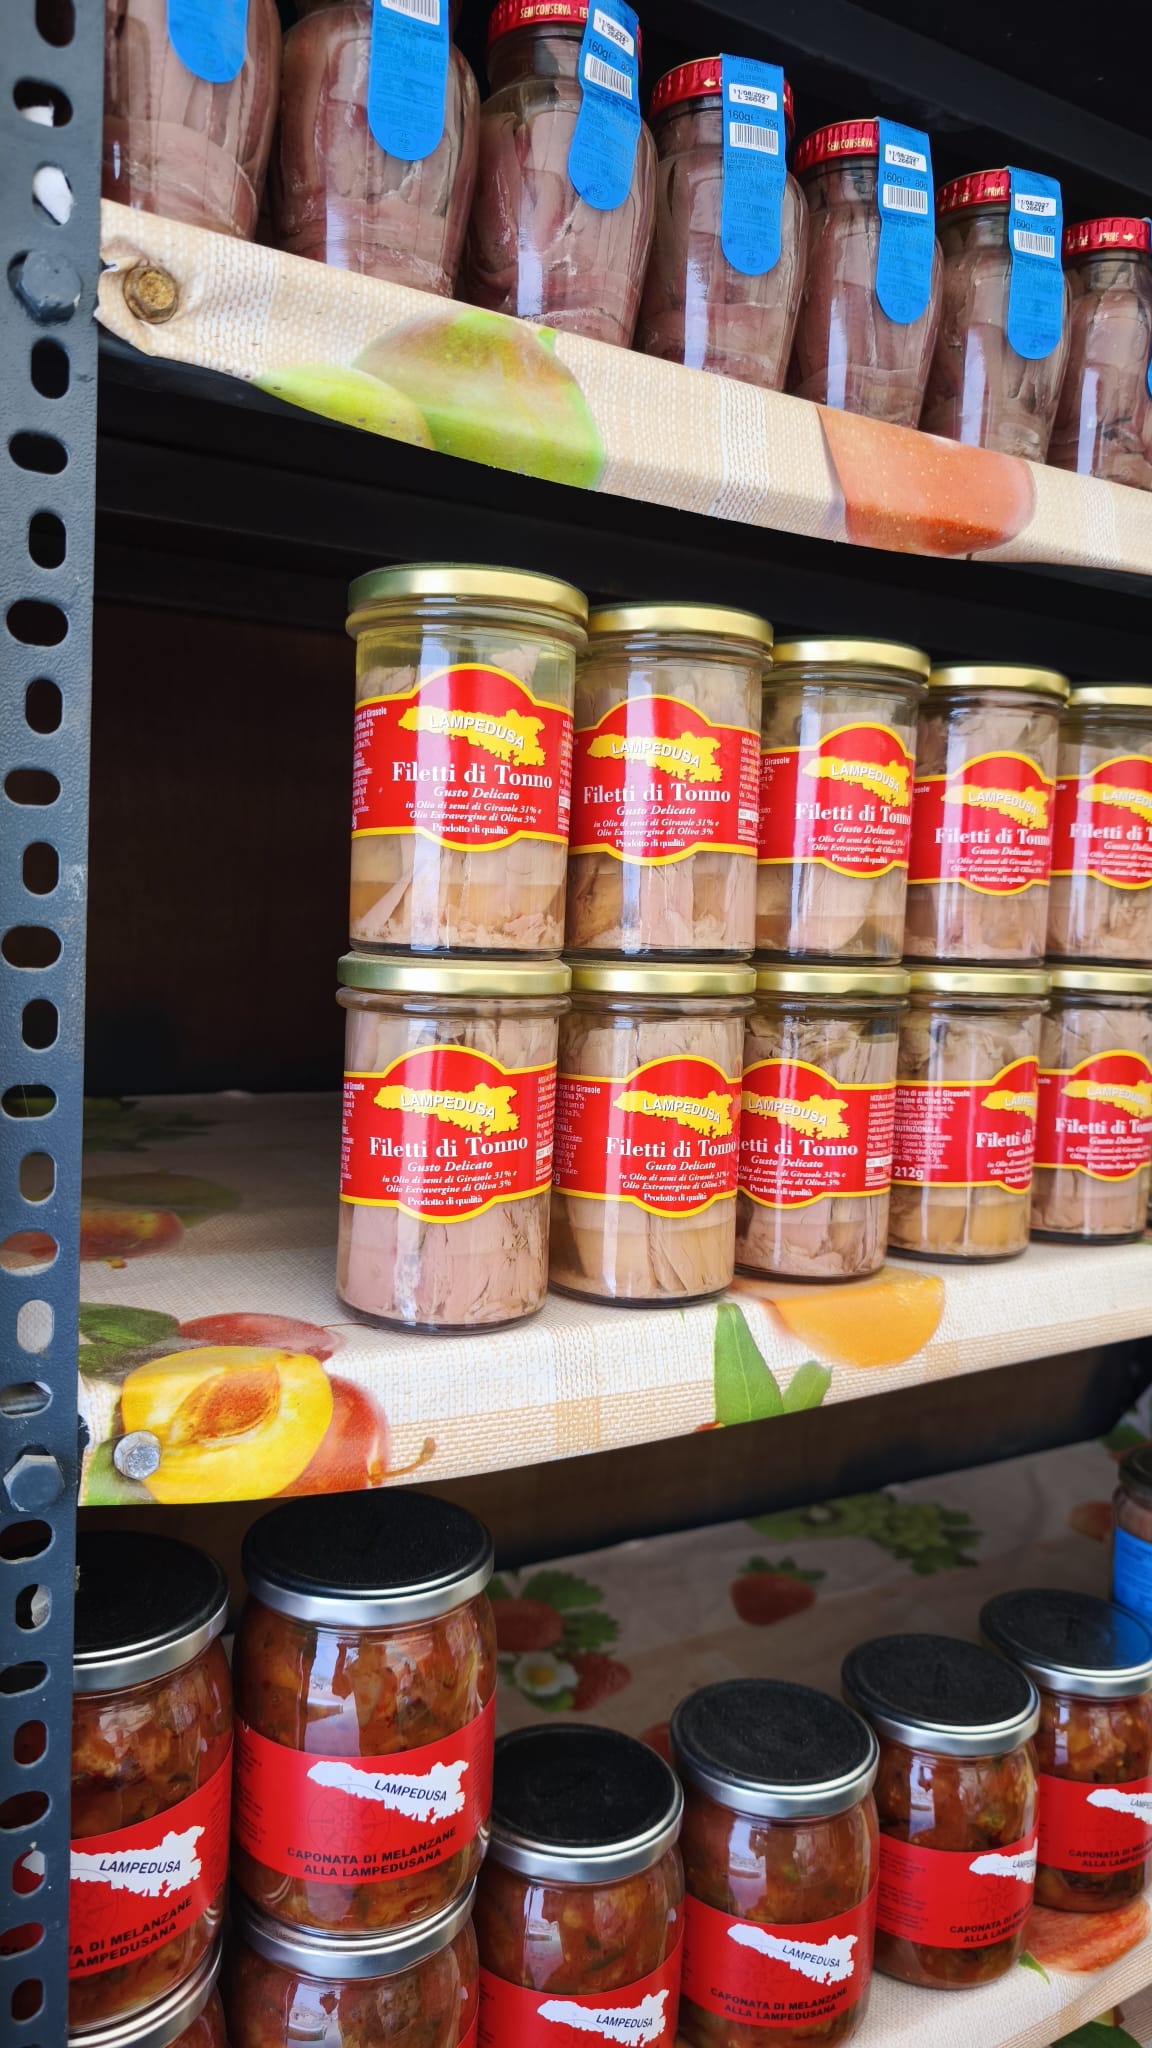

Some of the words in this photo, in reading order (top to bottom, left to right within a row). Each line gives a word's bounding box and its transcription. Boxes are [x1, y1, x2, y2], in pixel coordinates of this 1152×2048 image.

[588, 38, 608, 62] 160g
[728, 109, 750, 123] 160g
[430, 714, 525, 750] LAMPEDUSA
[611, 742, 701, 768] LAMPEDUSA
[391, 761, 456, 783] Filetti
[463, 762, 487, 784] di
[494, 764, 553, 789] Tonno
[831, 763, 900, 793] LAMPEDUSA
[433, 786, 469, 798] Gusto
[471, 787, 520, 801] Delicato
[583, 785, 636, 805] Filetti
[642, 783, 663, 802] di
[670, 783, 731, 803] Tonno
[405, 801, 414, 809] in
[416, 800, 435, 810] Olio
[437, 800, 447, 810] di
[448, 802, 469, 811] semi
[471, 802, 481, 811] di
[483, 803, 519, 813] Girasole
[520, 805, 537, 814] 31%
[616, 805, 651, 816] Gusto
[651, 805, 697, 816] Delicato
[968, 791, 1038, 816] LAMPEDUSA
[409, 810, 428, 820] Olio
[430, 810, 488, 823] Extravergine
[489, 812, 499, 822] di
[500, 813, 523, 823] Oliva
[523, 815, 537, 824] 3%
[794, 803, 852, 821] Filetti
[858, 804, 876, 822] di
[431, 822, 470, 834] Prodotto
[471, 824, 480, 834] di
[481, 825, 509, 836] qualità
[602, 819, 618, 828] Olio
[649, 818, 660, 827] di
[661, 818, 695, 827] Girasole
[695, 819, 714, 827] 31%
[833, 823, 862, 834] Gusto
[597, 829, 612, 837] Olio
[665, 827, 675, 836] di
[677, 827, 699, 836] Oliva
[700, 828, 714, 836] 3%
[836, 835, 846, 843] di
[862, 836, 871, 844] di
[934, 827, 990, 844] Filetti
[995, 828, 1013, 844] di
[1070, 823, 1122, 840] Filetti
[1126, 825, 1143, 841] di
[615, 839, 649, 848] Prodotto
[650, 838, 658, 848] di
[659, 838, 685, 848] qualità
[399, 1094, 496, 1119] LAMPEDUSA
[643, 1098, 721, 1124] LAMPEDUSA
[748, 1098, 828, 1127] LAMPEDUSA
[1056, 1117, 1107, 1134] Filetti
[1110, 1119, 1126, 1135] di
[975, 1131, 1021, 1148] Filetti
[1021, 1128, 1031, 1145] di
[369, 1136, 428, 1158] Filetti
[435, 1137, 458, 1158] di
[465, 1135, 528, 1156] Tonno
[605, 1136, 666, 1158] Filetti
[672, 1140, 691, 1158] di
[697, 1138, 737, 1157] Tonno
[774, 1139, 792, 1156] di
[798, 1138, 859, 1157] Tonno
[407, 1161, 441, 1174] Gusto
[444, 1160, 493, 1172] Delicato
[645, 1161, 677, 1172] Gusto
[679, 1160, 716, 1171] Delicato
[750, 1155, 778, 1166] Gusto
[781, 1157, 824, 1169] Delicato
[382, 1175, 390, 1183] in
[391, 1175, 410, 1185] Olio
[411, 1175, 422, 1184] di
[423, 1175, 444, 1184] semi
[445, 1174, 455, 1184] di
[456, 1172, 492, 1184] Girasole
[493, 1169, 511, 1180] 31%
[629, 1172, 647, 1182] Olio
[648, 1172, 658, 1182] di
[657, 1174, 679, 1182] semi
[679, 1172, 688, 1182] di
[753, 1165, 762, 1175] di
[790, 1168, 822, 1179] Girasole
[823, 1169, 841, 1179] 31%
[894, 1166, 924, 1181] 212g
[386, 1184, 404, 1194] Olio
[405, 1183, 461, 1195] Extravergine
[462, 1183, 472, 1193] di
[474, 1181, 497, 1192] Oliva
[498, 1179, 512, 1189] 3%
[622, 1181, 640, 1190] Olio
[642, 1182, 693, 1193] Extravergine
[694, 1181, 701, 1190] di
[750, 1183, 780, 1195] Prodotto
[795, 1175, 804, 1186] di
[805, 1177, 826, 1187] Oliva
[407, 1196, 444, 1207] Prodotto
[445, 1196, 454, 1206] di
[455, 1194, 483, 1207] qualità
[643, 1193, 677, 1202] Prodotto
[678, 1193, 686, 1202] di
[686, 1192, 707, 1203] qualità
[374, 1779, 447, 1801] LAMPEDUSA
[287, 1846, 358, 1865] CAPONATA
[363, 1853, 377, 1863] DI
[381, 1828, 457, 1862] MELANZANE
[1068, 1849, 1120, 1858] CAPONATA
[99, 1858, 182, 1875] LAMPEDUSA
[303, 1864, 337, 1877] ALLA
[342, 1849, 441, 1877] LAMPEDUSANA
[89, 1940, 105, 1953] DI
[110, 1896, 192, 1946] MELANZANE
[950, 1920, 1002, 1933] CAPONATA
[963, 1933, 988, 1943] ALLA
[782, 1944, 841, 1968] LAMPEDUSA
[709, 1987, 770, 2010] CAPONATA
[789, 1986, 848, 2011] MELANZANE
[723, 2005, 752, 2017] ALLA
[756, 2004, 836, 2021] LAMPEDUSANA
[596, 2014, 653, 2028] LAMPEDUSA
